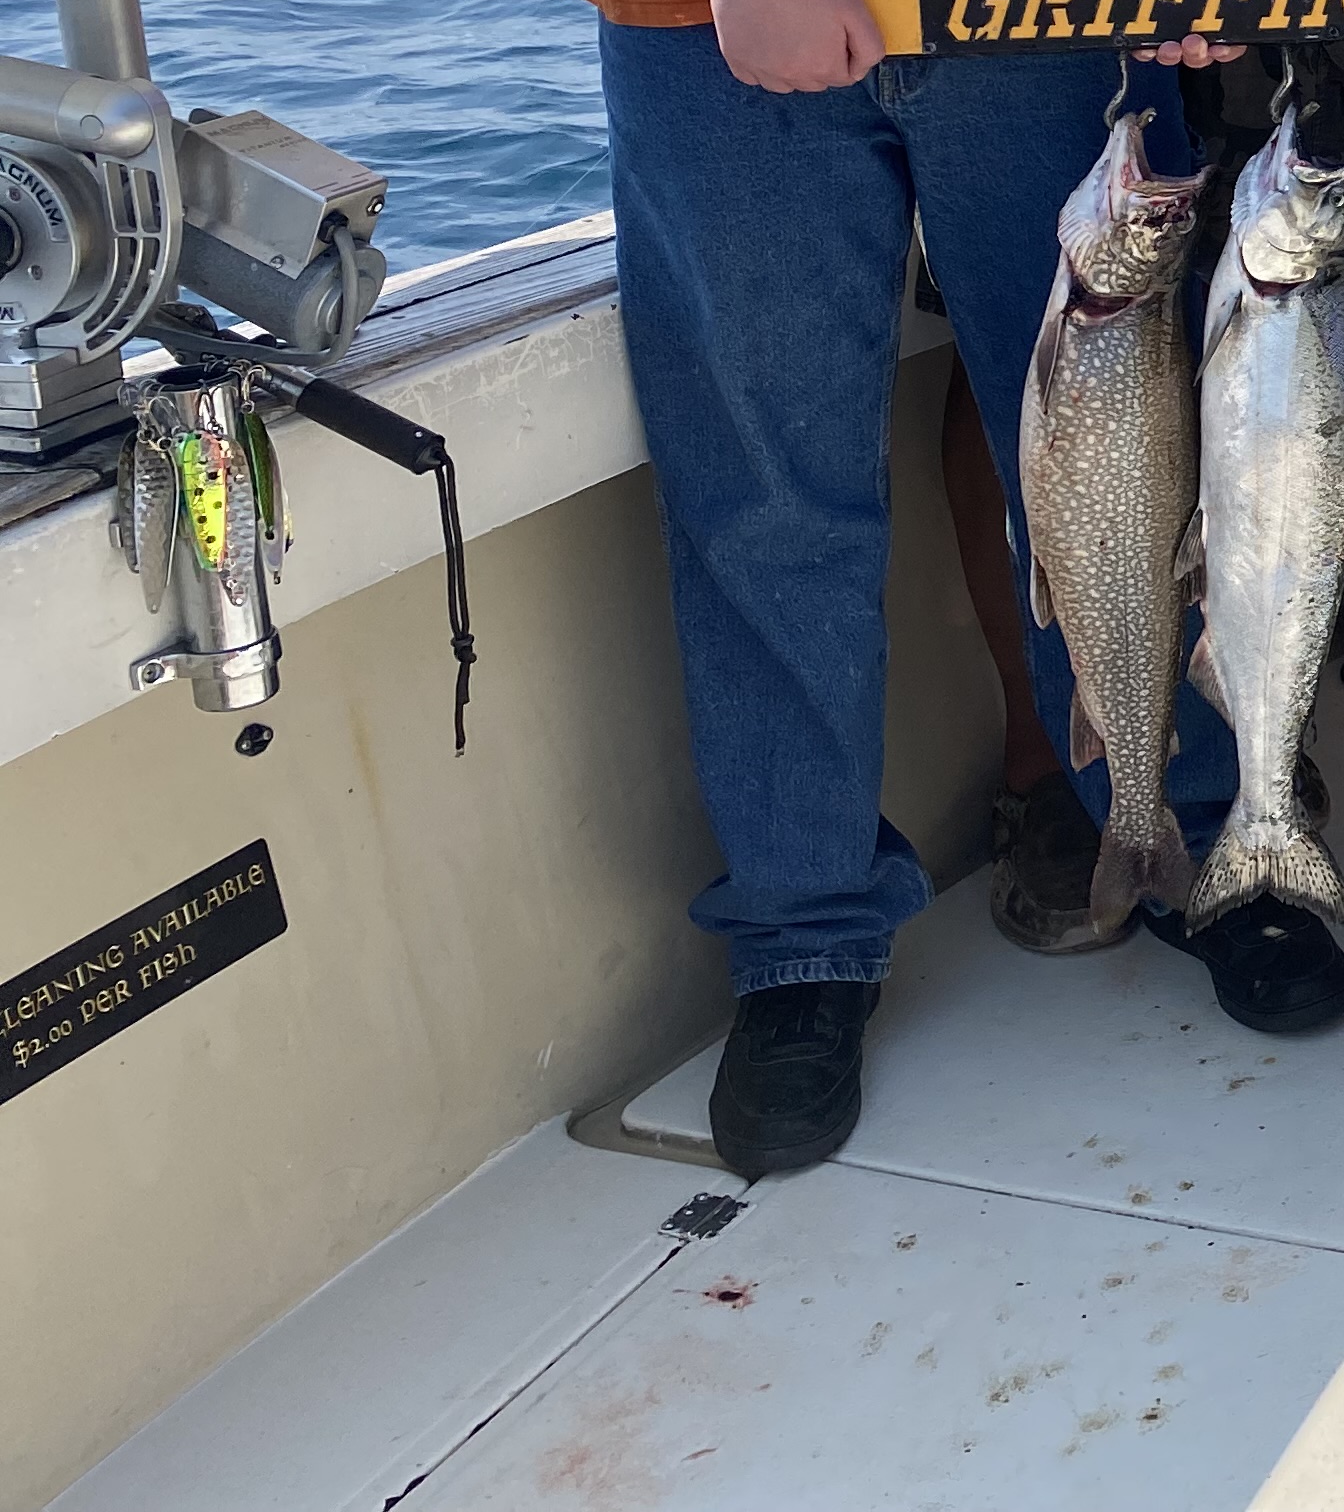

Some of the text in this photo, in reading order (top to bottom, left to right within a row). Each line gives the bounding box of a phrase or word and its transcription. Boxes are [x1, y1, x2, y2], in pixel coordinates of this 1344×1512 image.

[129, 861, 267, 956] AVAILABLE
[12, 1019, 74, 1069] $2.00
[77, 978, 134, 1026] PER
